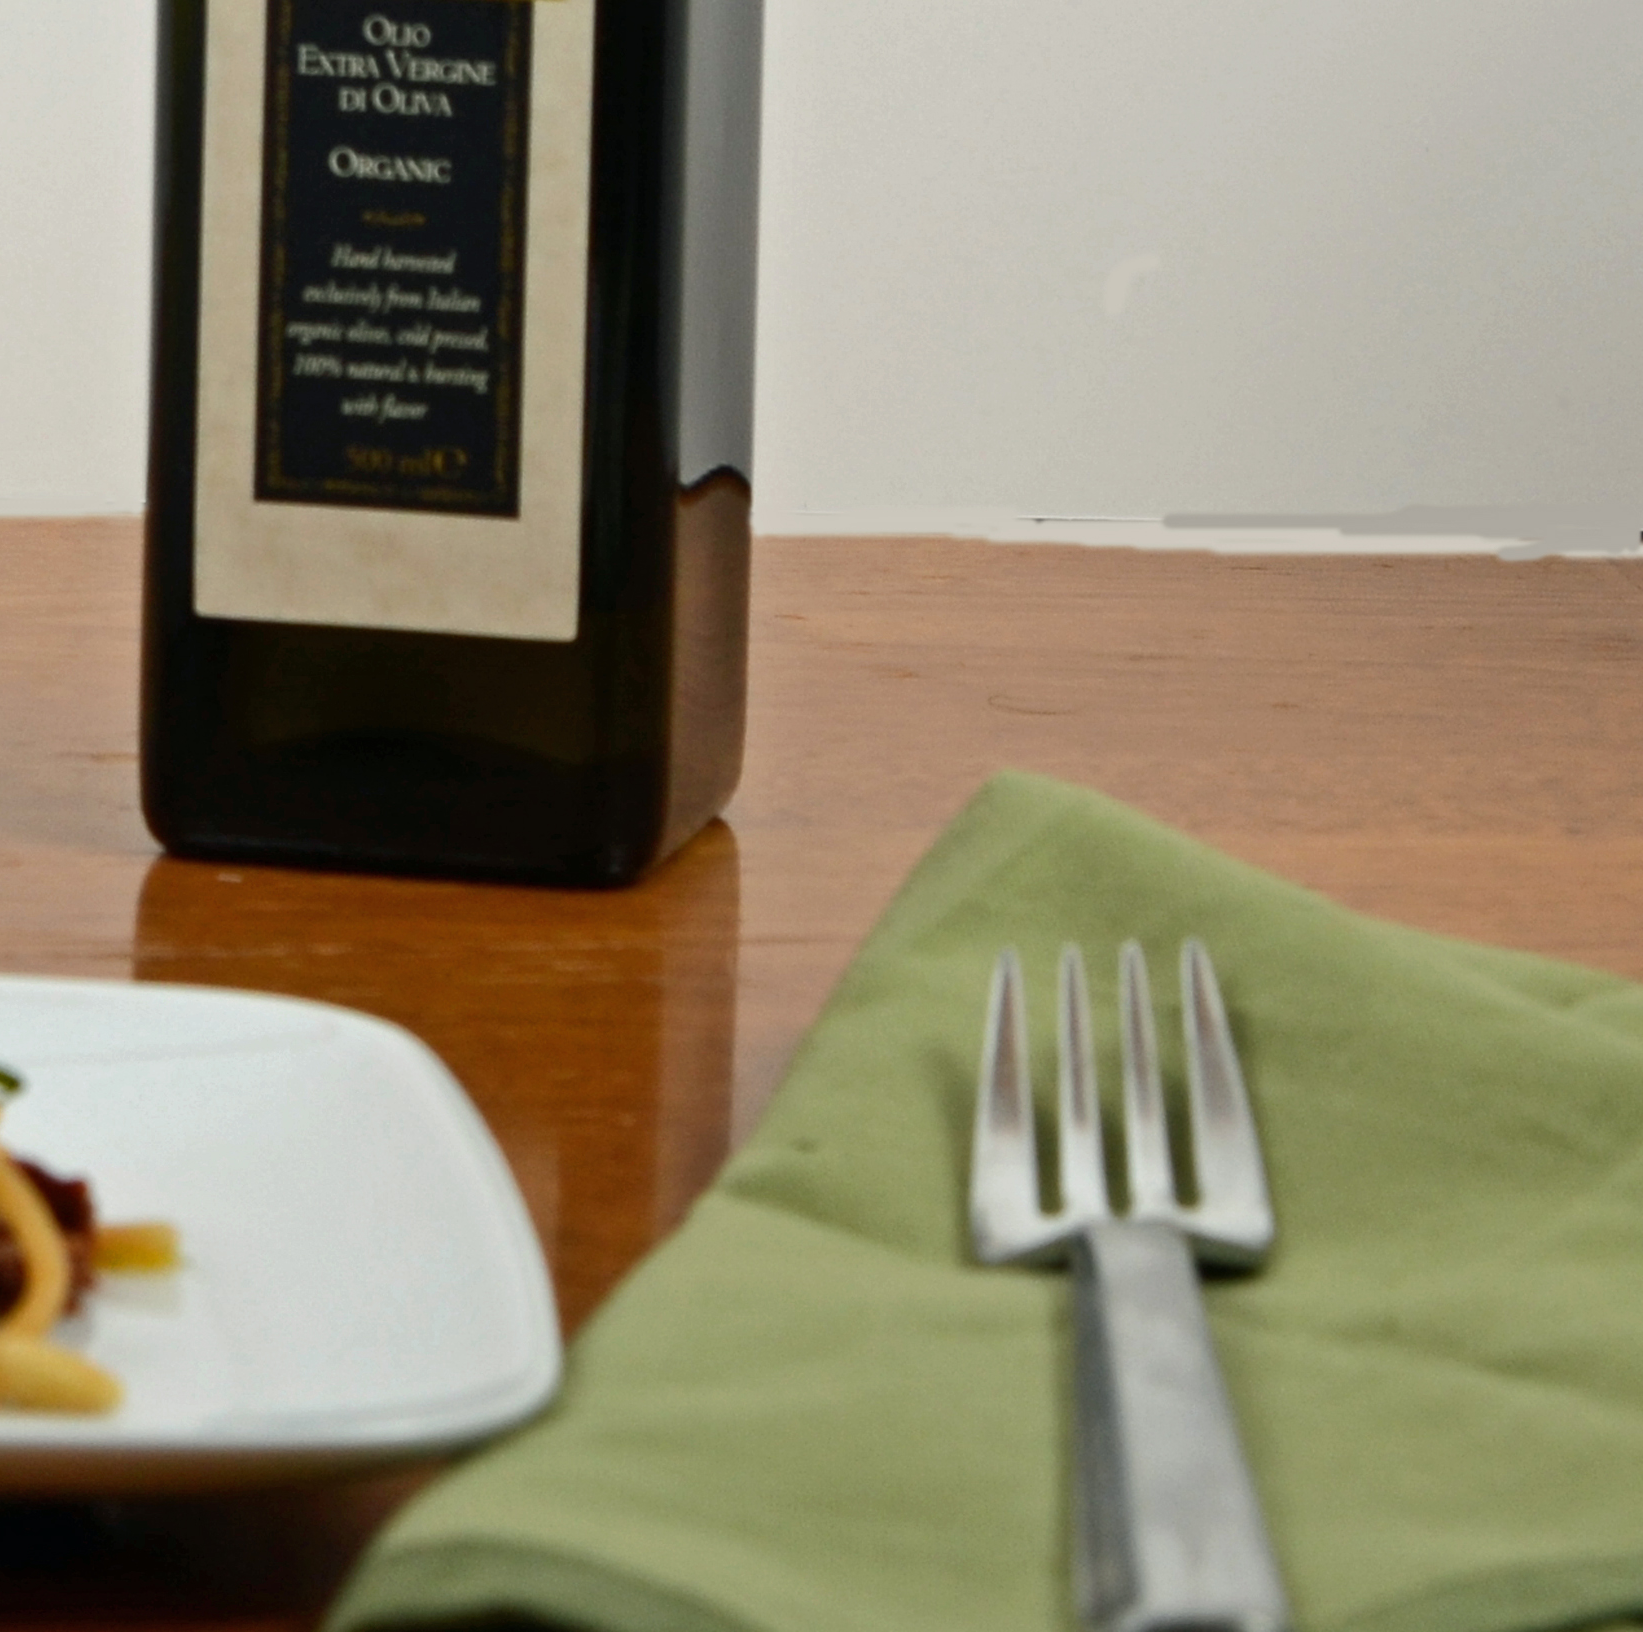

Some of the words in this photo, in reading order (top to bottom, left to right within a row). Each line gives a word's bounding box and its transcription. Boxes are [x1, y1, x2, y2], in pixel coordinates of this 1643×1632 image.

[297, 45, 380, 78] EXTRA
[385, 51, 497, 86] VERGINE
[372, 84, 453, 117] OLIVA
[328, 147, 453, 184] ORGANIC
[332, 243, 381, 268] Hand
[384, 247, 457, 274] harvested
[304, 282, 382, 313] exclusively
[382, 285, 424, 314] from
[429, 288, 482, 312] Italian
[287, 323, 343, 345] organic
[397, 325, 431, 347] cold
[295, 355, 343, 378] 100%
[348, 359, 407, 382] natural
[425, 362, 489, 394] bursting
[342, 394, 378, 416] with
[379, 395, 429, 424] flavor
